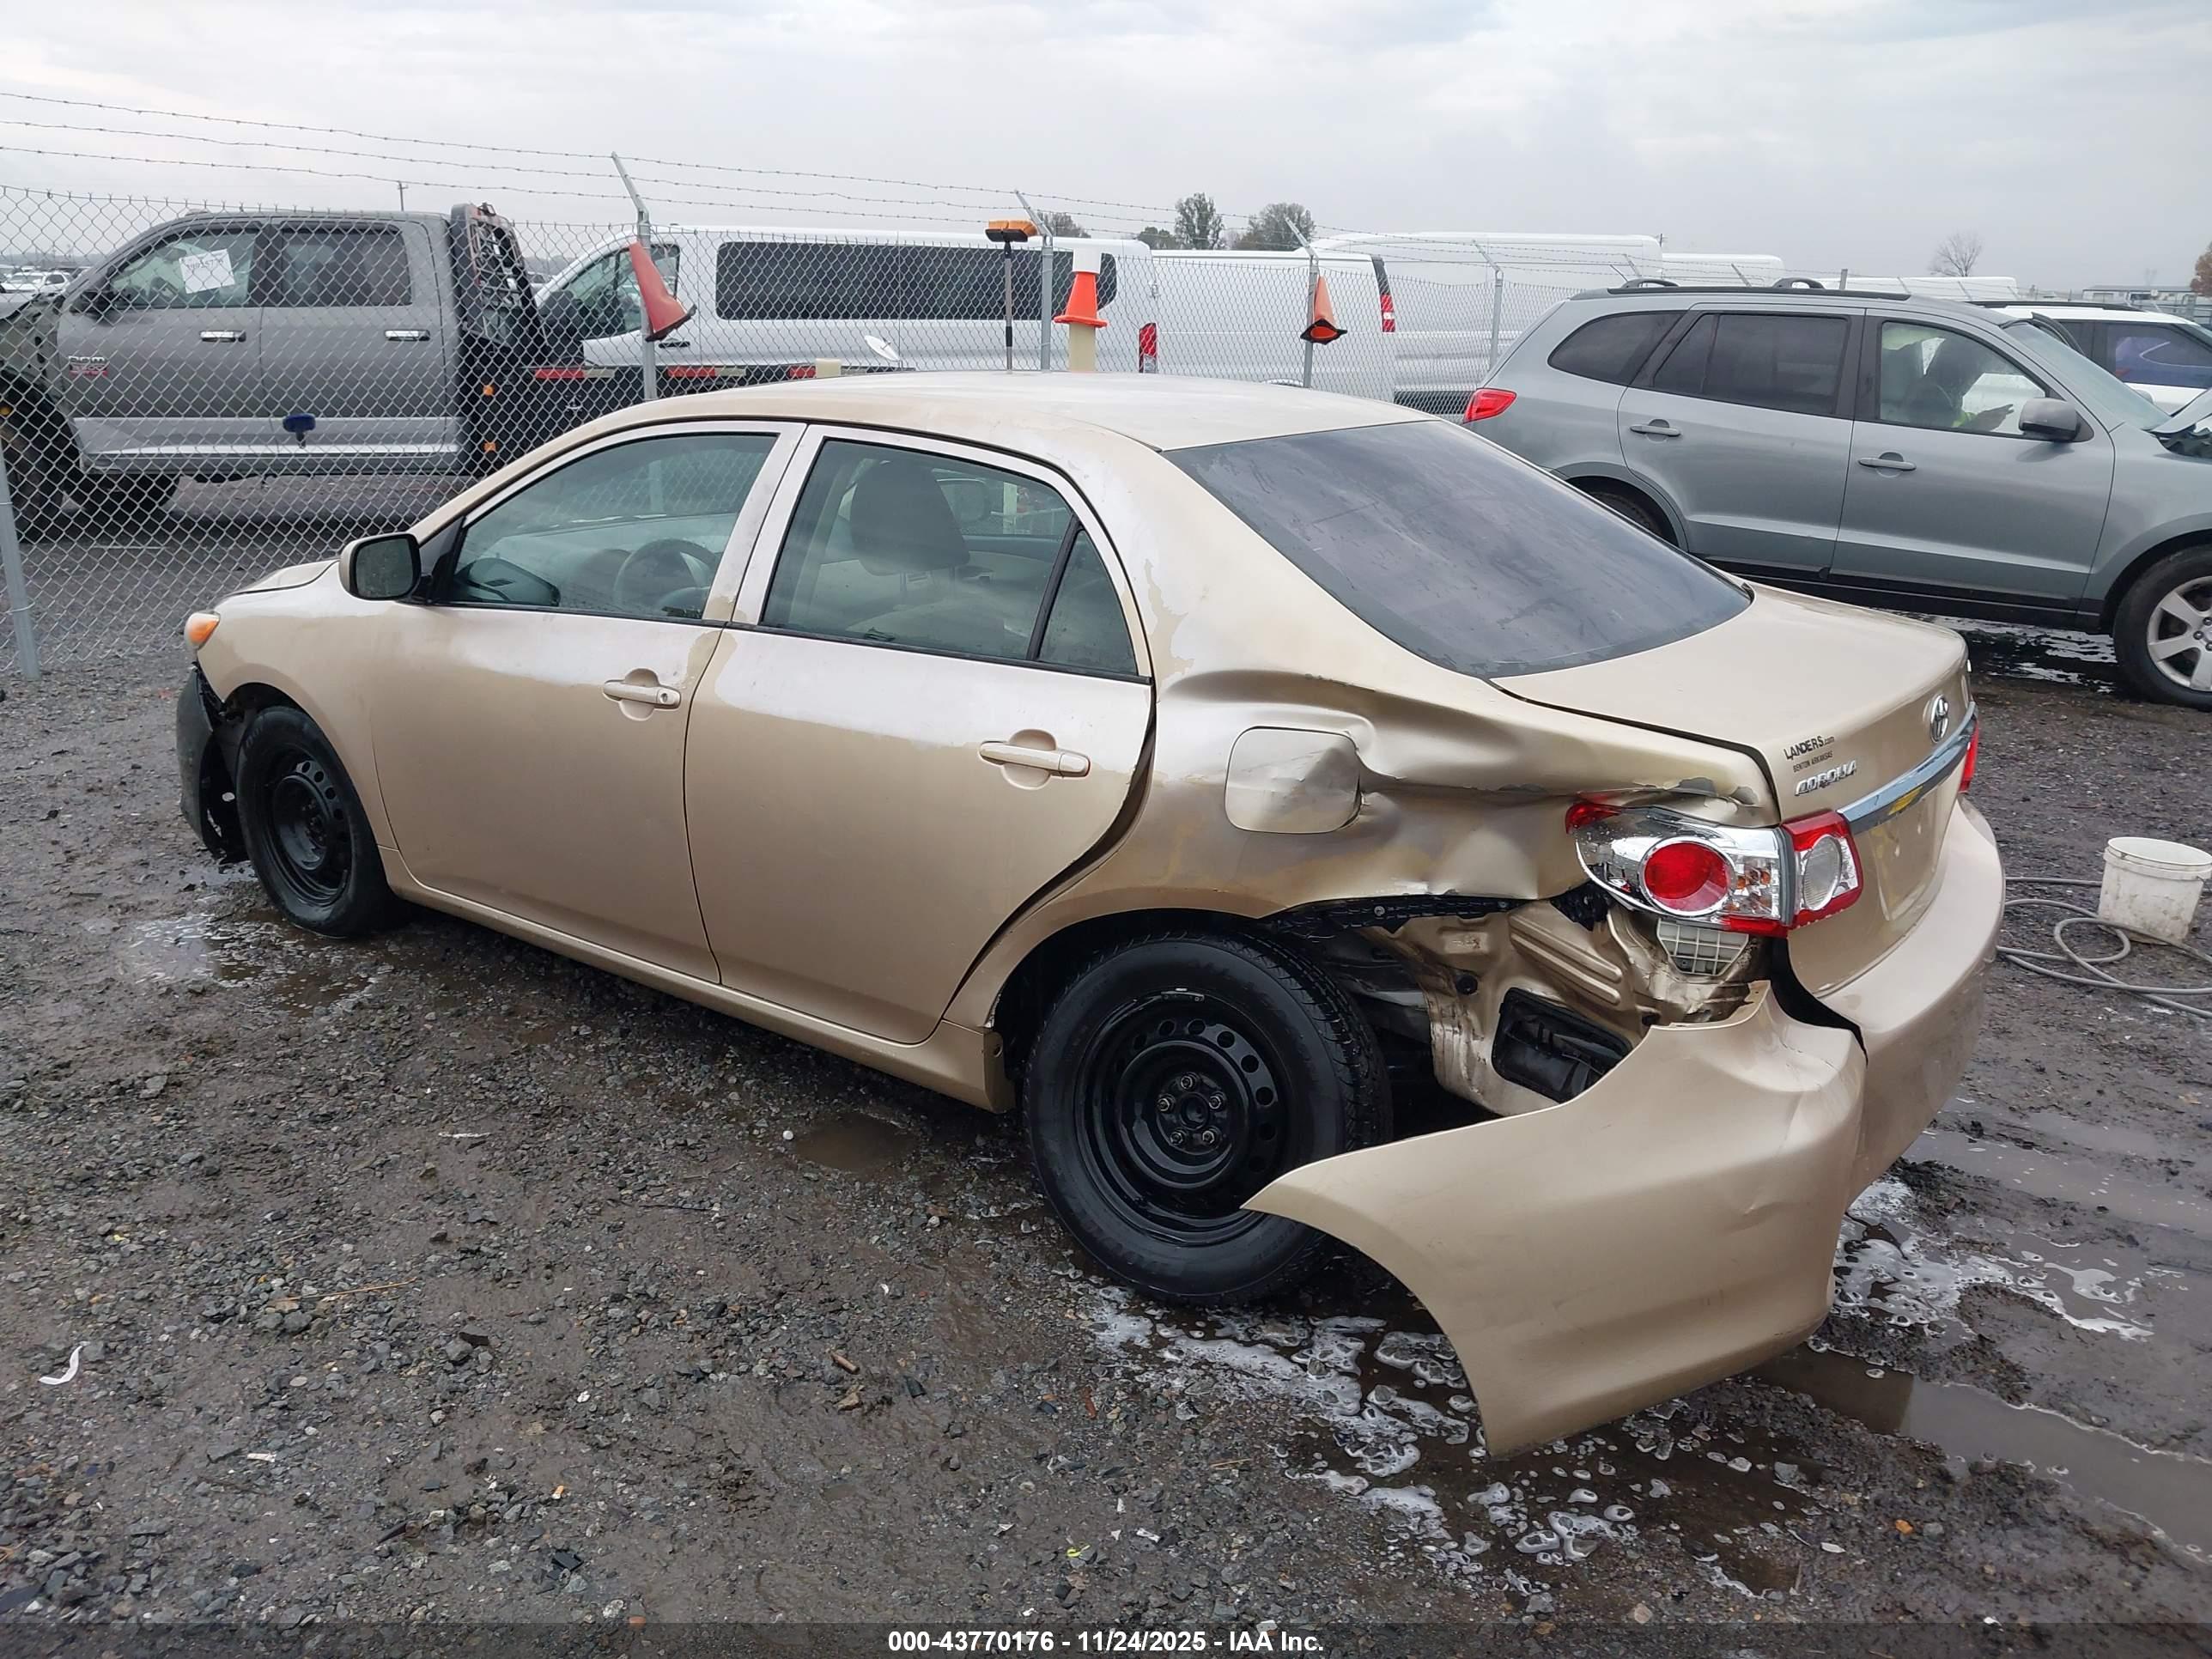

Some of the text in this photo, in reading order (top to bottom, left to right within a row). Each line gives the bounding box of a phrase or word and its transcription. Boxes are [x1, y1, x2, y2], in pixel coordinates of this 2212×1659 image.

[1784, 736, 1834, 760] LANDERS.com
[1793, 750, 1833, 773] BENTON ARKANSAS
[1795, 760, 1856, 796] COROLLA
